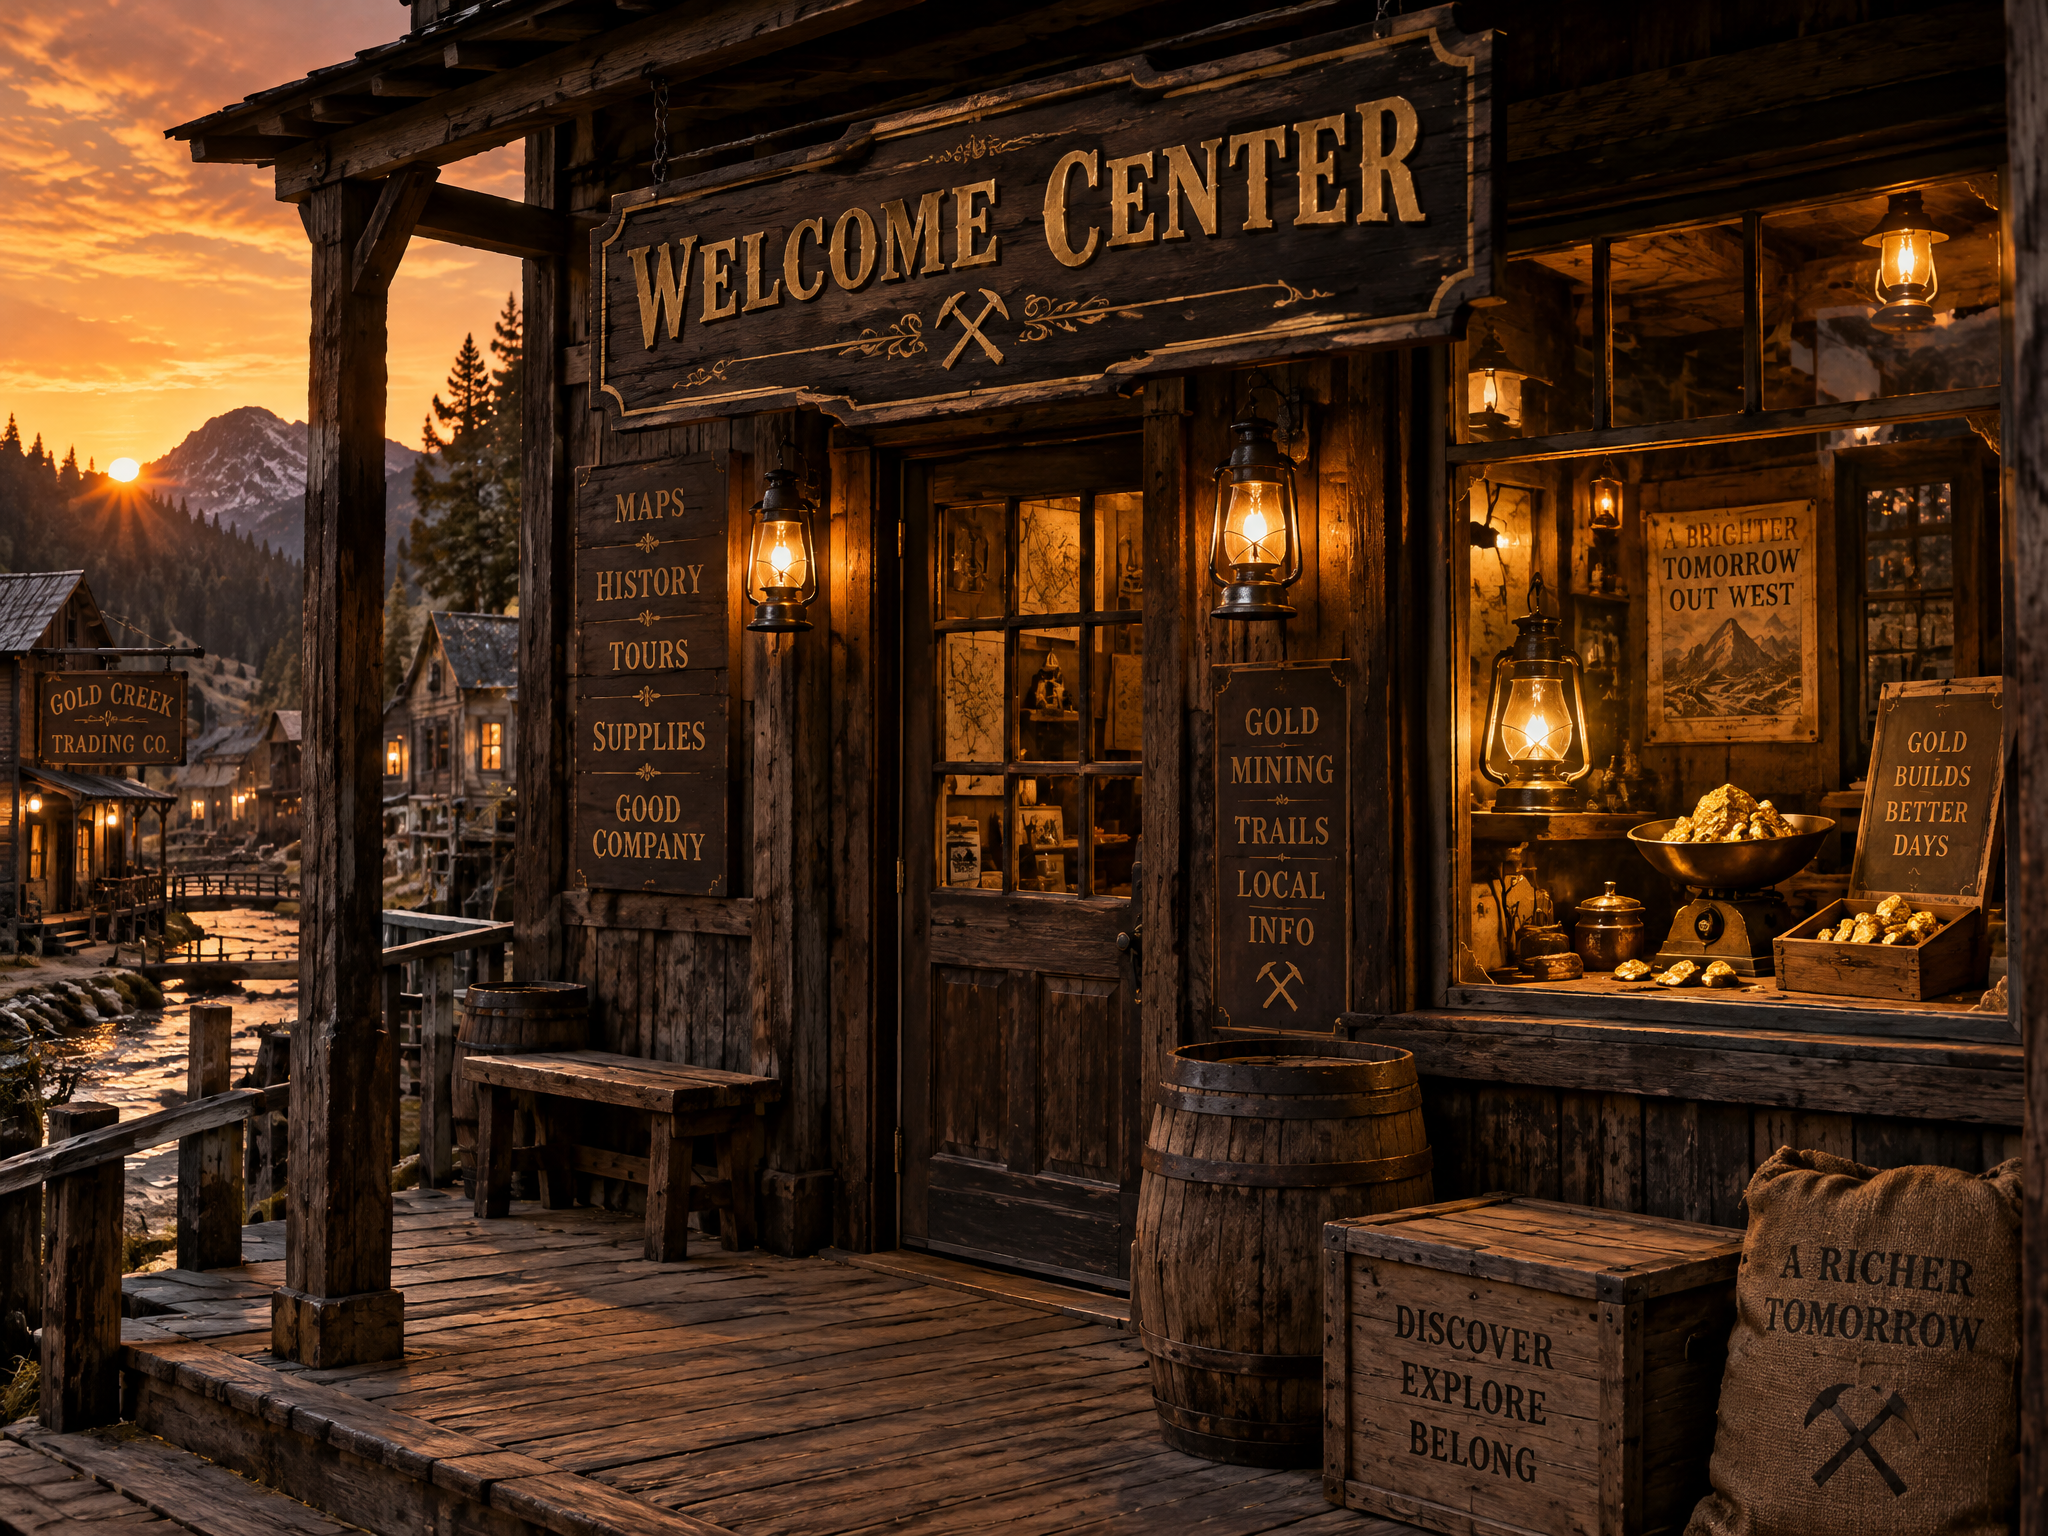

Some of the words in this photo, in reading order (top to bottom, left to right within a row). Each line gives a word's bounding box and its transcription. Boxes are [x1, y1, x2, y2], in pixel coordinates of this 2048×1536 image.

[627, 178, 998, 351] WELCOME
[1042, 94, 1427, 269] CENTER
[615, 487, 685, 523] MAPS
[1663, 527, 1679, 549] A
[1685, 516, 1799, 548] BRIGHTER
[1662, 548, 1800, 581] TOMORROW
[596, 564, 704, 601] HISTORY
[1669, 587, 1718, 612] OUT
[1728, 582, 1795, 608] WEST
[609, 639, 689, 670] TOURS
[50, 684, 102, 716] GOLD
[110, 682, 175, 717] CREEK
[593, 720, 706, 752] SUPPLIES
[1245, 706, 1319, 736] GOLD
[51, 734, 135, 753] TRADING
[143, 735, 170, 753] CO.
[1907, 730, 1968, 754] GOLD
[1231, 754, 1334, 784] MINING
[1893, 764, 1971, 788] BUILDS
[615, 793, 681, 823] GOOD
[1885, 801, 1968, 825] BETTER
[592, 829, 705, 861] COMPANY
[1235, 816, 1329, 845] TRAILS
[1892, 834, 1949, 857] DAYS
[1237, 870, 1325, 900] LOCAL
[1248, 915, 1314, 946] INFO
[1779, 1245, 1803, 1279] A
[1818, 1244, 1975, 1298] RICHER
[1394, 1304, 1554, 1370] DISCOVER
[1764, 1296, 1985, 1352] TOMORROW
[1400, 1360, 1547, 1427] EXPLORE
[1409, 1419, 1537, 1485] BELONG
